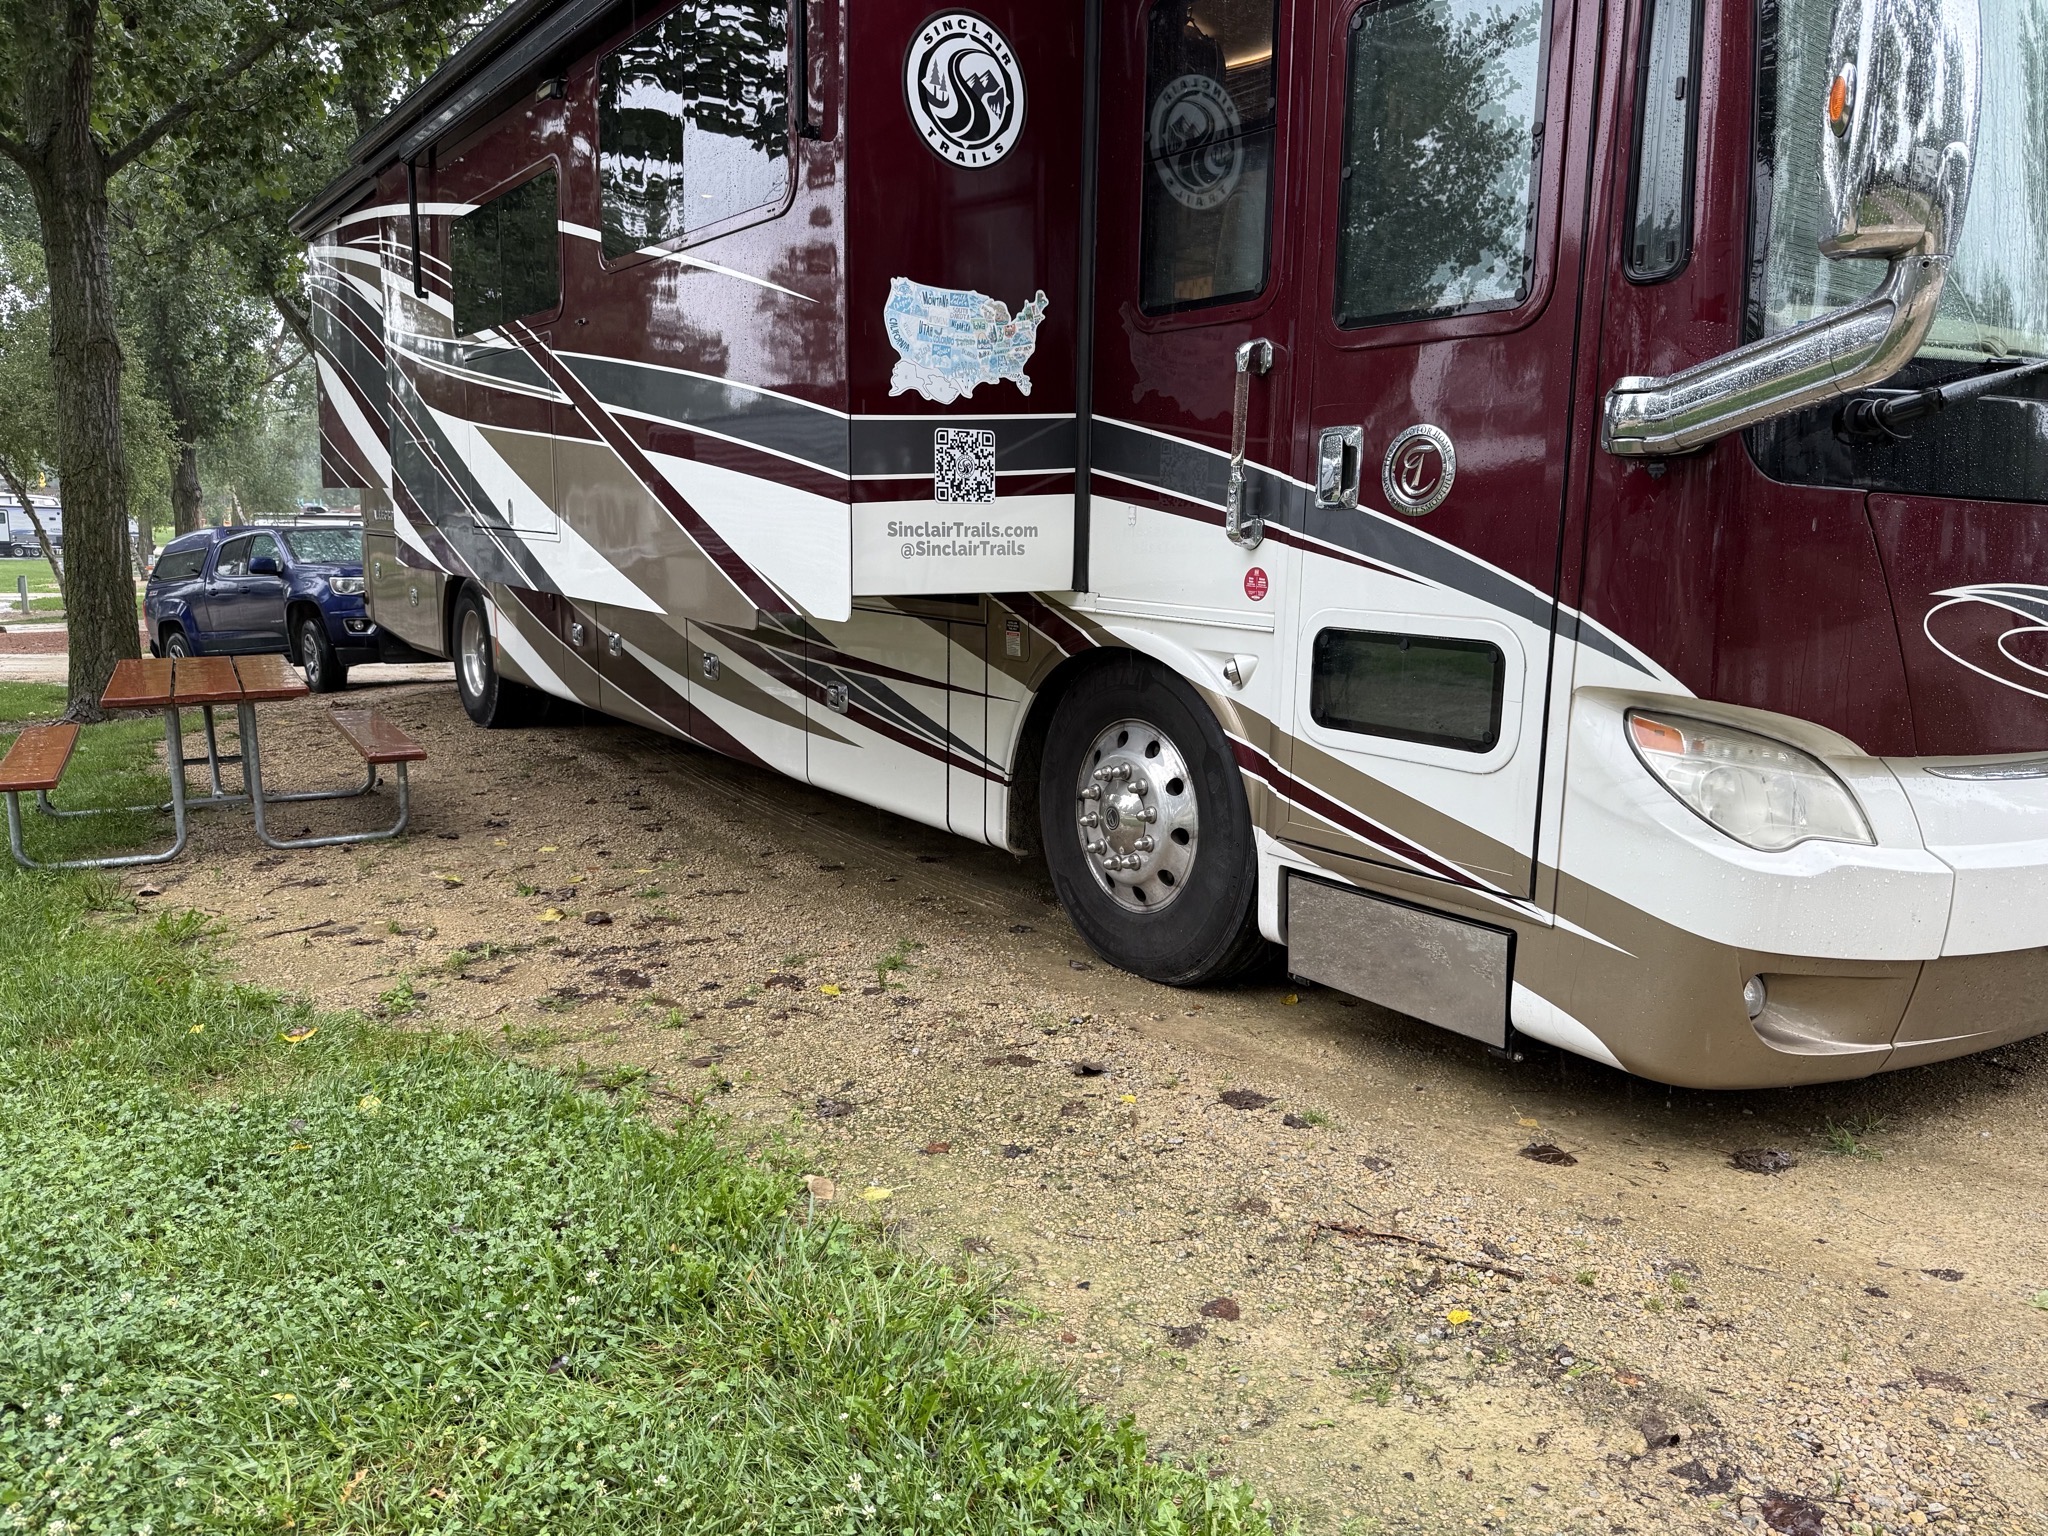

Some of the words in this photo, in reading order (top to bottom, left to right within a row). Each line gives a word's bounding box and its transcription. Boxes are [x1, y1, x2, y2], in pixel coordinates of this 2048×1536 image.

[923, 19, 1012, 66] SINCLAIR
[927, 126, 1004, 163] TRAILS
[922, 290, 949, 307] MONTANA
[889, 317, 910, 352] CALIFORNIA
[933, 335, 955, 346] COLORADO
[887, 520, 1038, 538] SinclairTrails.com
[900, 541, 1026, 559] @SinclairTrails
